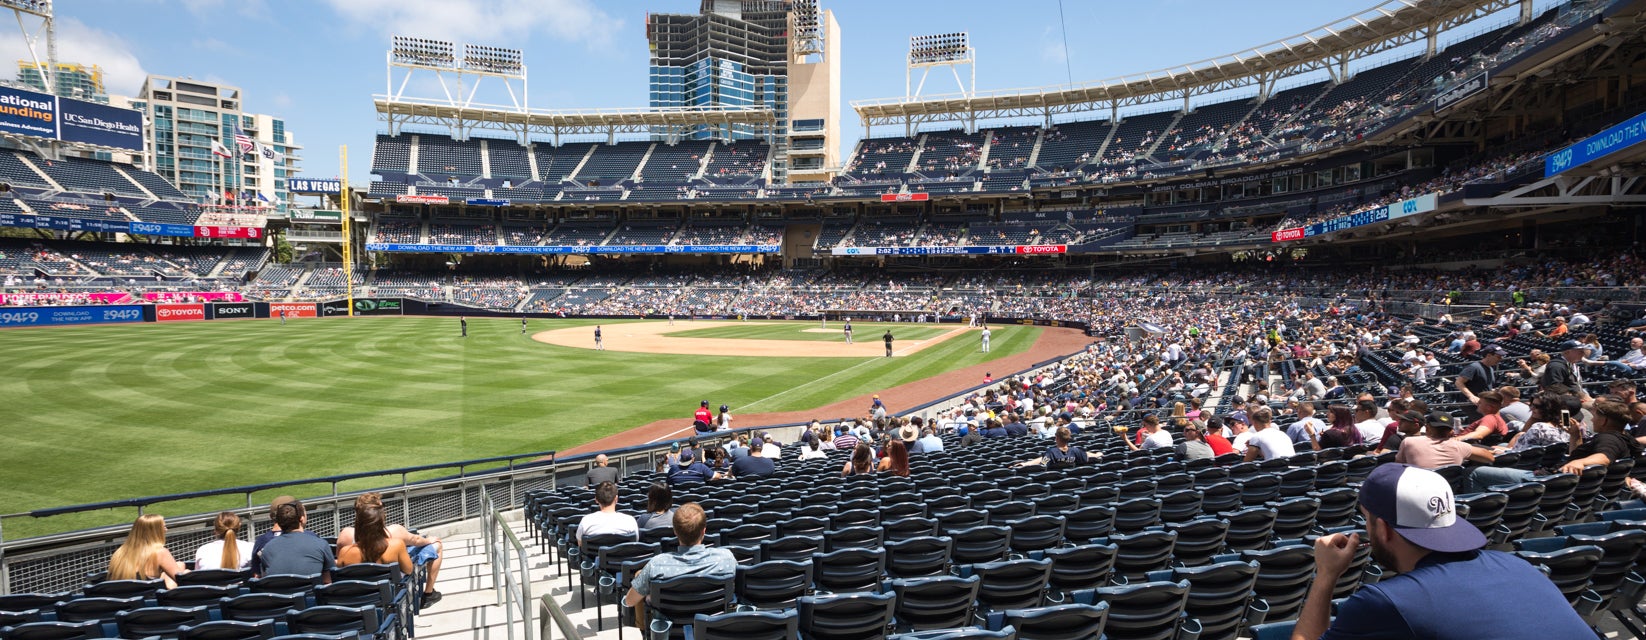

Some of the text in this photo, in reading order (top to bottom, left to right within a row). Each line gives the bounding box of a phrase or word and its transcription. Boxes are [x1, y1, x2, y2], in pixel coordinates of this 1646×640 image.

[64, 112, 140, 132] UC San Diego Health
[1586, 130, 1624, 156] DOWNLOAD
[1625, 122, 1640, 140] THE
[290, 180, 340, 192] LAS VEGAS
[1180, 180, 1218, 190] COLEMAN
[1220, 174, 1270, 184] BROADCAST
[1272, 168, 1303, 177] CENTER
[1376, 208, 1388, 220] 2:02
[1282, 230, 1300, 239] TOYOTA
